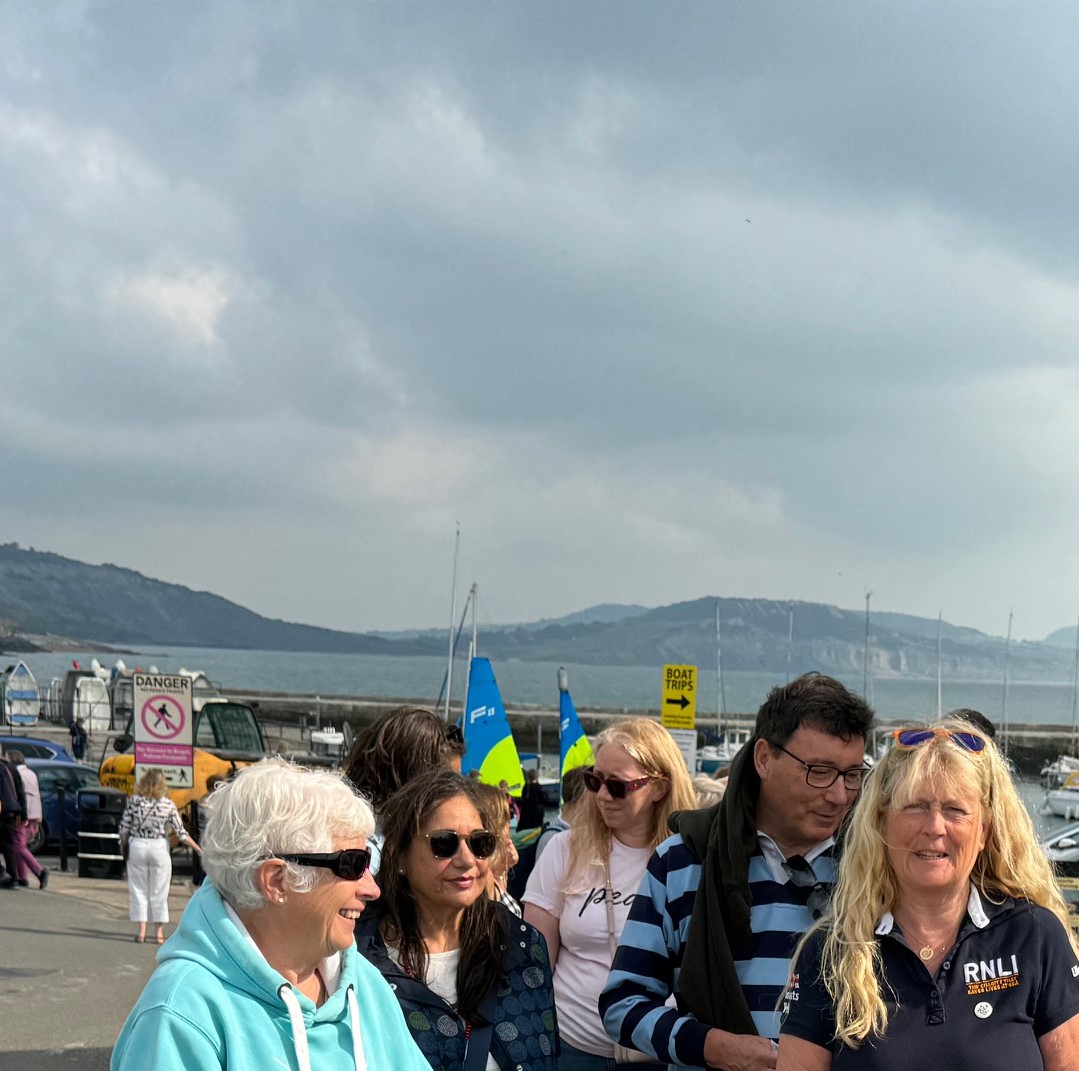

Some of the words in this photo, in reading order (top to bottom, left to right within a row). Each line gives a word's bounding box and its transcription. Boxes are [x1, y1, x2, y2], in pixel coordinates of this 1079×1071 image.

[666, 668, 694, 679] BOAT
[135, 676, 189, 690] DANGER
[666, 680, 694, 691] TRIPS
[963, 954, 1019, 983] RNLI
